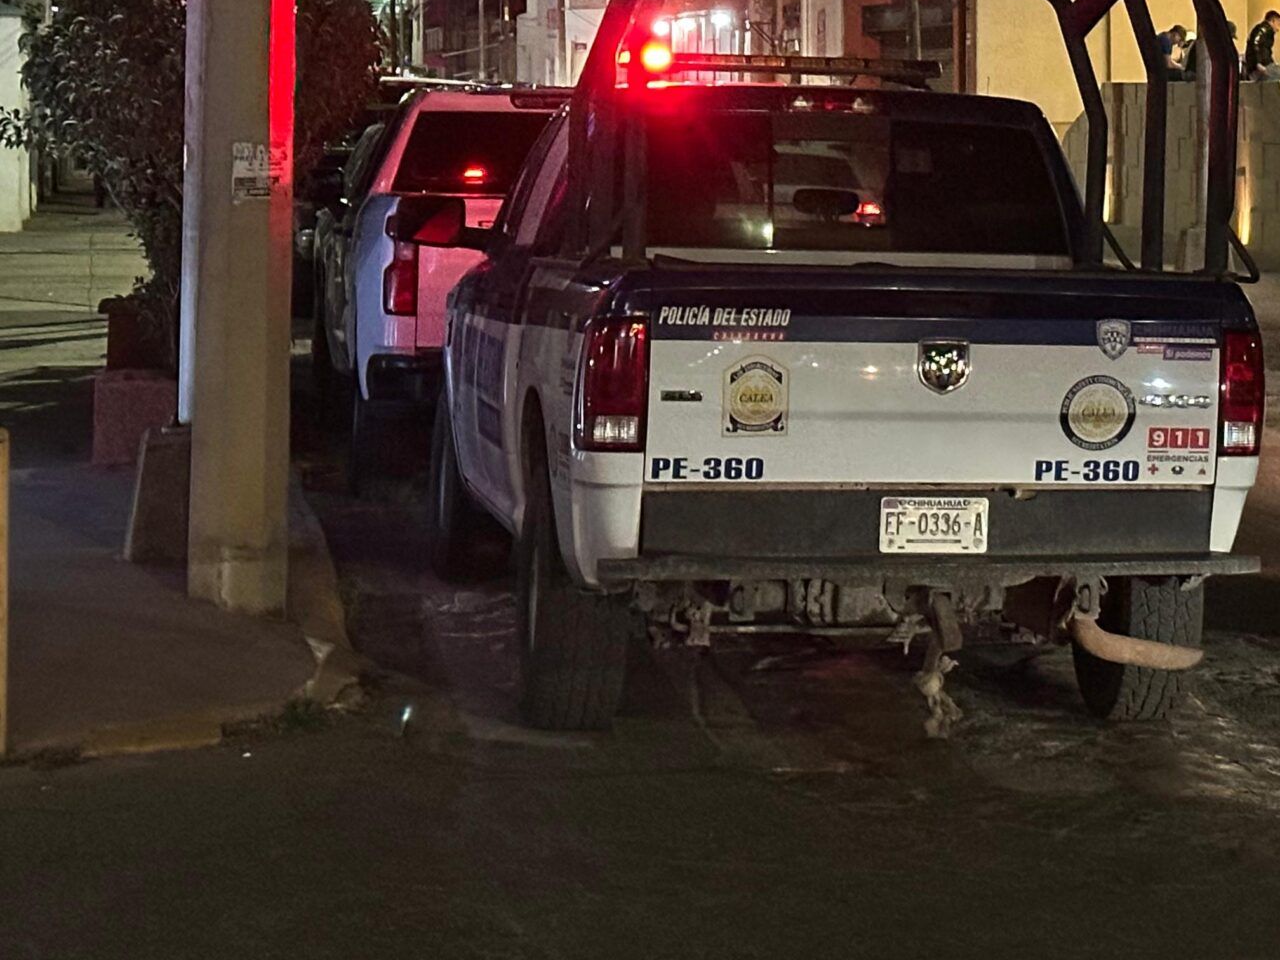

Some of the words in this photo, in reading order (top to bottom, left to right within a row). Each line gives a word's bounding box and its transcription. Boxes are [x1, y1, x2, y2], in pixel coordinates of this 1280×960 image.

[659, 305, 710, 325] POLICÍA
[712, 308, 737, 326] DEL
[740, 308, 791, 326] ESTADO
[739, 393, 774, 403] CALEA
[1150, 430, 1207, 447] 911
[651, 457, 764, 480] PE-360
[1034, 460, 1140, 482] PE-360
[885, 512, 984, 536] EF-0336-A
